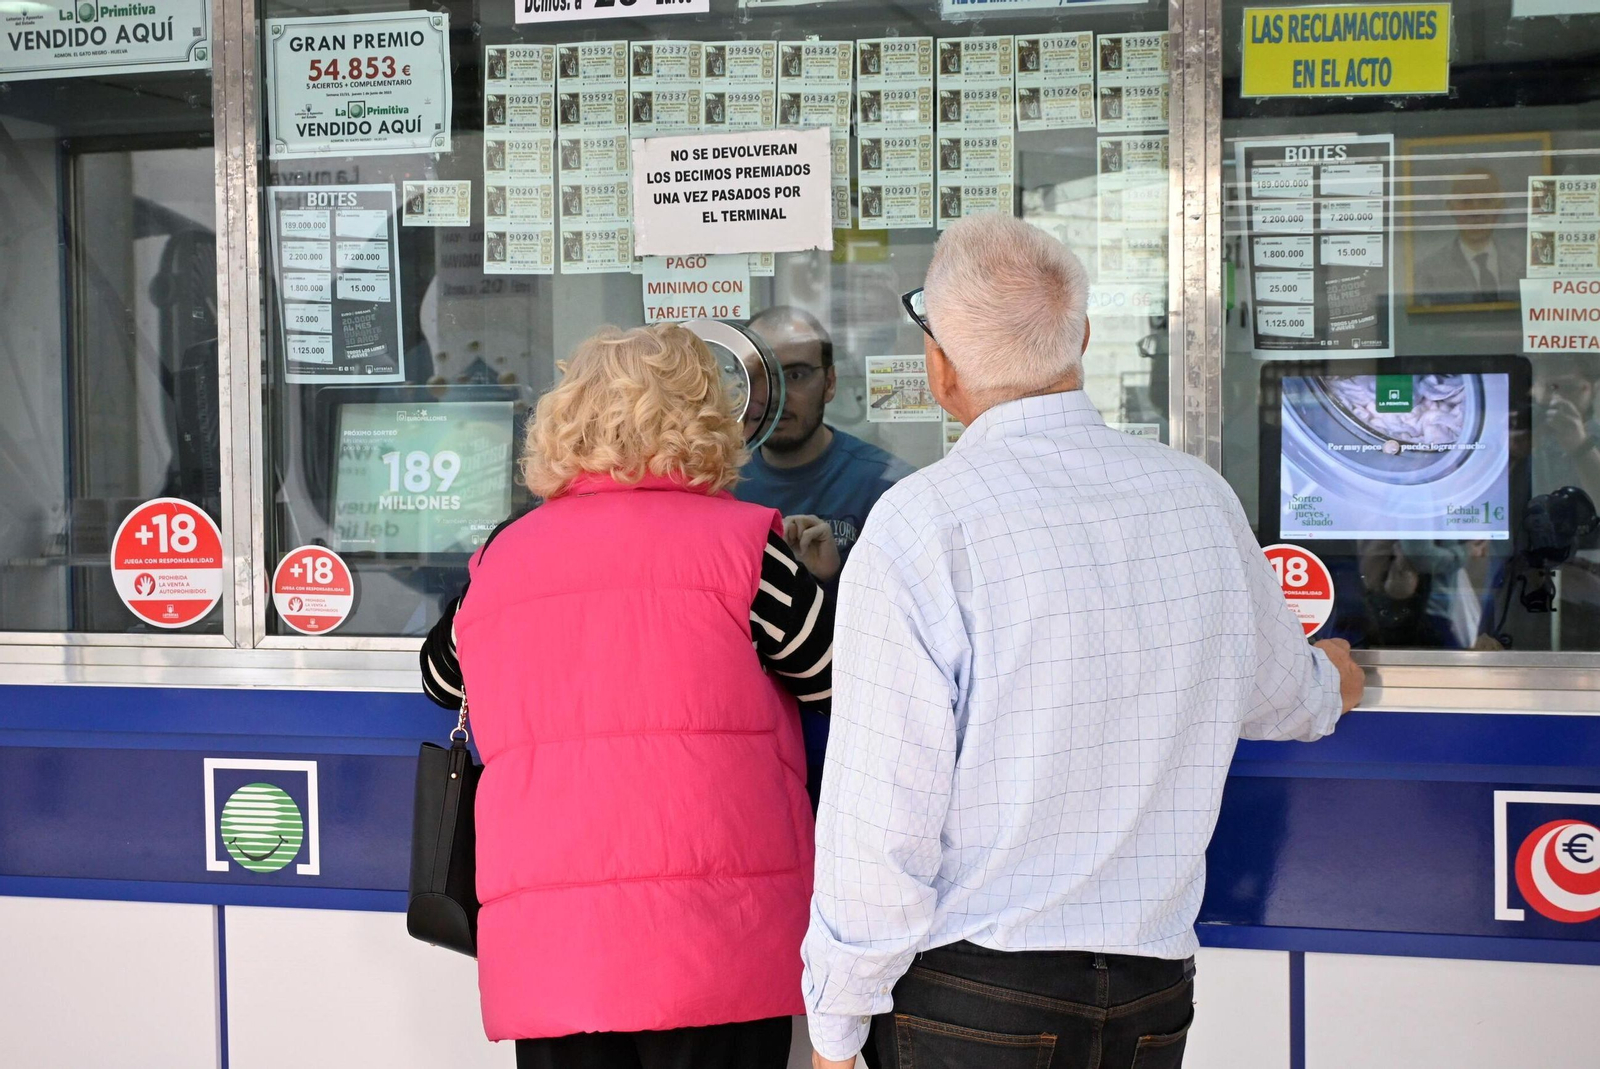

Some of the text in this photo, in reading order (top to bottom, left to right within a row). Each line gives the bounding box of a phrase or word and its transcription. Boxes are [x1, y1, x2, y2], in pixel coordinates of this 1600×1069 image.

[59, 5, 156, 21] La Primitiva
[1252, 10, 1437, 43] LAS RECLAMACIONES
[8, 16, 173, 51] VENDIDO AQUÍ
[290, 30, 424, 52] GRAN PREMIO
[1043, 40, 1077, 48] 01076
[1126, 38, 1159, 47] 51965
[656, 46, 687, 54] 76337
[884, 43, 916, 51] 90201
[964, 42, 997, 50] 80538
[510, 50, 540, 58] 90201
[582, 47, 613, 56] 59592
[729, 47, 761, 55] 99496
[805, 47, 837, 56] 04342
[308, 56, 411, 82] 54.853 €
[1293, 57, 1392, 88] EN EL ACTO
[350, 79, 412, 88] COMPLEMENTARIO
[884, 91, 917, 100] 90201
[964, 91, 997, 99] 80538
[1044, 88, 1077, 97] 01076
[1126, 88, 1159, 96] 51965
[509, 96, 539, 104] 90201
[582, 93, 613, 101] 59592
[728, 94, 760, 102] 99496
[804, 95, 835, 103] 04342
[335, 106, 409, 116] La Primitiva
[296, 116, 421, 137] VENDIDO AQUÍ
[584, 140, 615, 148] 59592
[884, 139, 917, 147] 90201
[964, 139, 997, 147] 80538
[671, 143, 798, 161] NO SE DEVOLVERAN
[1285, 145, 1347, 162] BOTES
[647, 164, 810, 184] LOS DECIMOS PREMIADOS
[1256, 180, 1308, 189] 189.000.000
[1560, 182, 1596, 190] 80538
[427, 186, 456, 194] 50875
[509, 188, 539, 196] 90201
[585, 186, 616, 194] 59592
[885, 187, 917, 195] 90201
[964, 188, 997, 196] 80538
[308, 192, 357, 206] BOTES
[654, 186, 801, 204] UNA VEZ PASADOS POR
[702, 208, 786, 223] EL TERMINAL
[1262, 215, 1304, 223] 2.200.000
[1330, 213, 1373, 222] 7.200.000
[510, 233, 539, 241] 90201
[586, 232, 616, 240] 59592
[1558, 234, 1596, 242] 80538
[1263, 250, 1304, 258] 1.800.000
[1338, 248, 1366, 256] 15.000
[666, 256, 707, 269] PAGO
[648, 280, 743, 294] MINIMO CON
[1553, 281, 1600, 294] PAGO
[647, 305, 741, 319] TARJETA 10 €
[1529, 308, 1600, 321] MINIMO
[1528, 336, 1600, 349] TARJETA
[892, 361, 924, 369] 24591
[1362, 444, 1381, 452] poco
[1401, 443, 1429, 452] puedes
[1430, 443, 1456, 452] lograr
[1458, 442, 1485, 450] mucho
[382, 450, 461, 493] 189
[1292, 494, 1322, 502] Sorteo
[379, 496, 461, 510] MILLONES
[1289, 501, 1316, 510] lunes,
[1295, 511, 1324, 520] jueves
[1446, 502, 1504, 524] Échala 1 €
[1302, 517, 1333, 526] sábado
[1446, 516, 1479, 526] por solo
[135, 513, 198, 553] +18
[834, 520, 857, 542] YORK
[290, 557, 333, 584] +18
[1270, 556, 1309, 587] 18
